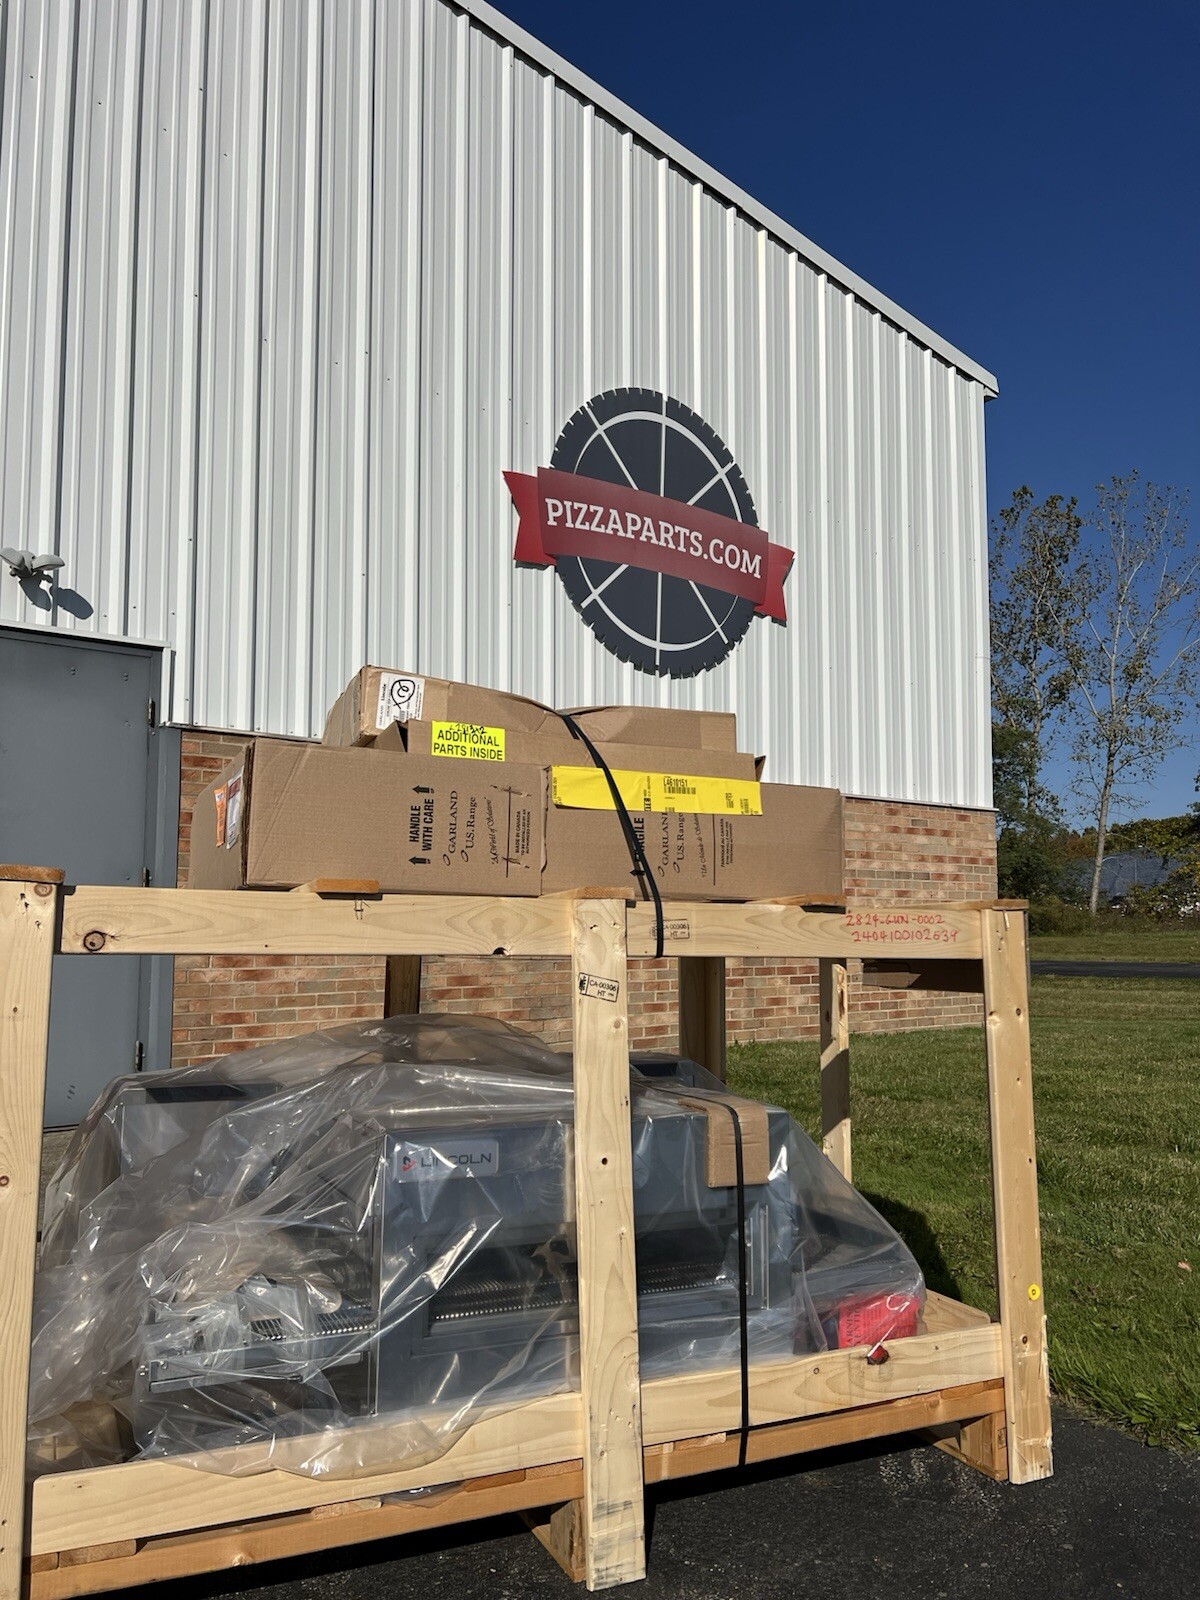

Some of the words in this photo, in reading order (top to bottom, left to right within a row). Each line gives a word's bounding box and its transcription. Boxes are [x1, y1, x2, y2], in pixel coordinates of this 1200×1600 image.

[544, 497, 762, 580] PIZZAPARTS.COM
[437, 730, 500, 747] ADDITIONAL
[433, 742, 467, 756] PARTS
[469, 747, 503, 761] INSIDE
[423, 798, 434, 824] CARE
[448, 790, 458, 854] GARLAND
[467, 796, 478, 828] Range
[409, 805, 421, 843] HANDLE
[422, 827, 433, 851] WITH
[466, 830, 475, 849] U.S.
[589, 979, 617, 992] CA-00306
[597, 989, 606, 997] HT
